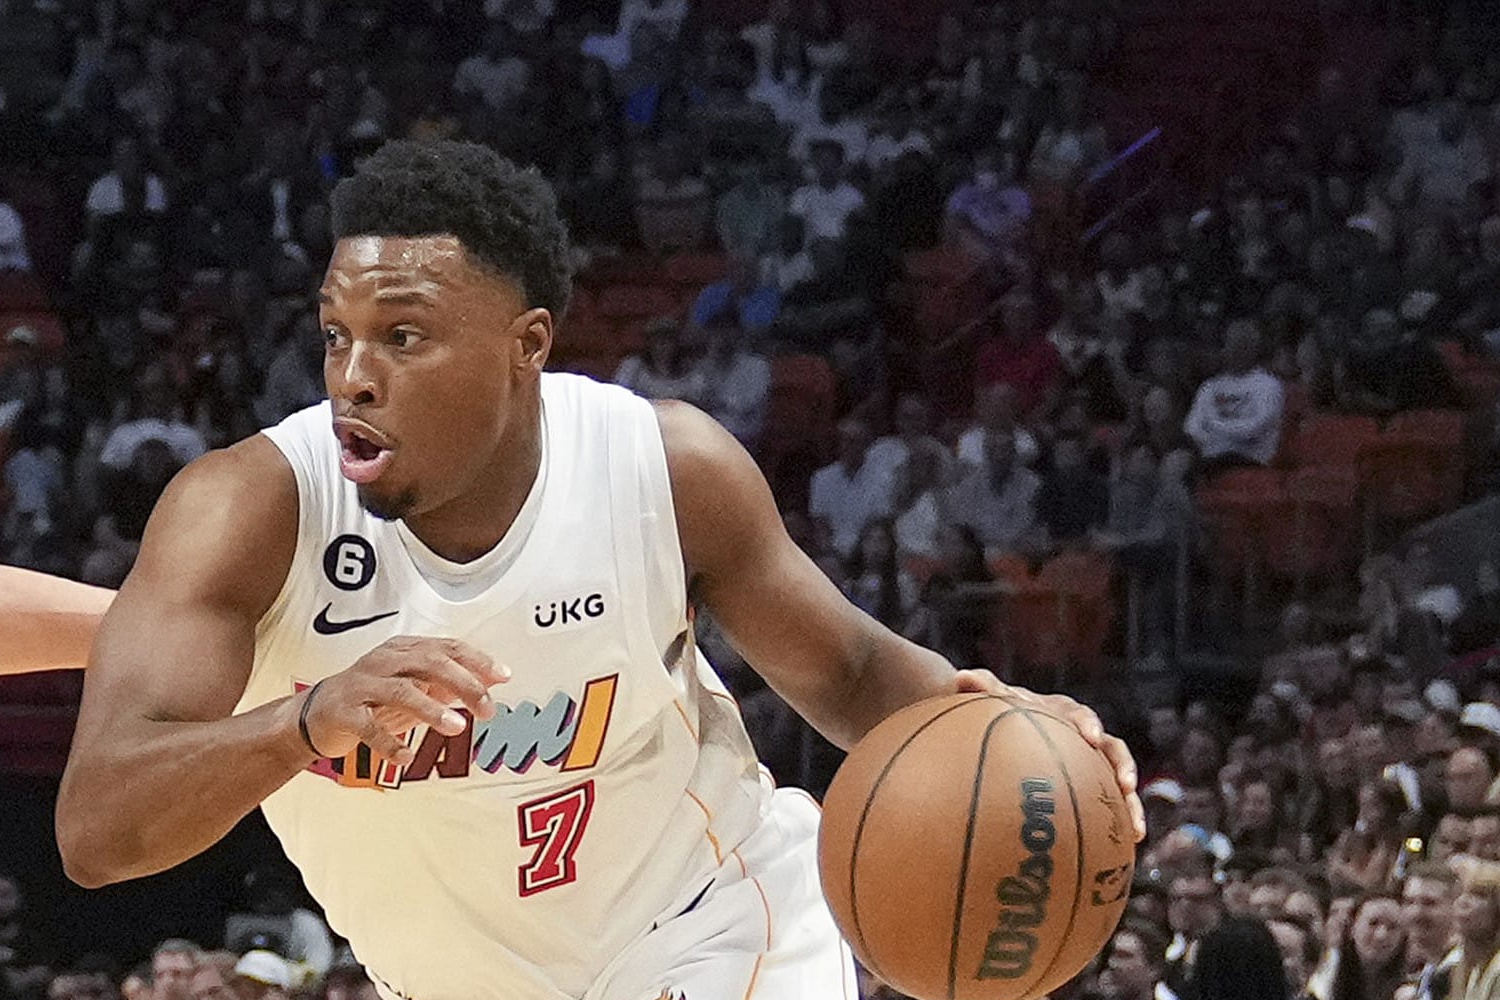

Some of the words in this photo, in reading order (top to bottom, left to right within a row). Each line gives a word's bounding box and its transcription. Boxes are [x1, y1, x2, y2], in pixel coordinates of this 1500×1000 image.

[334, 542, 366, 585] 6
[517, 779, 596, 898] 7
[974, 776, 1057, 981] Wilson
